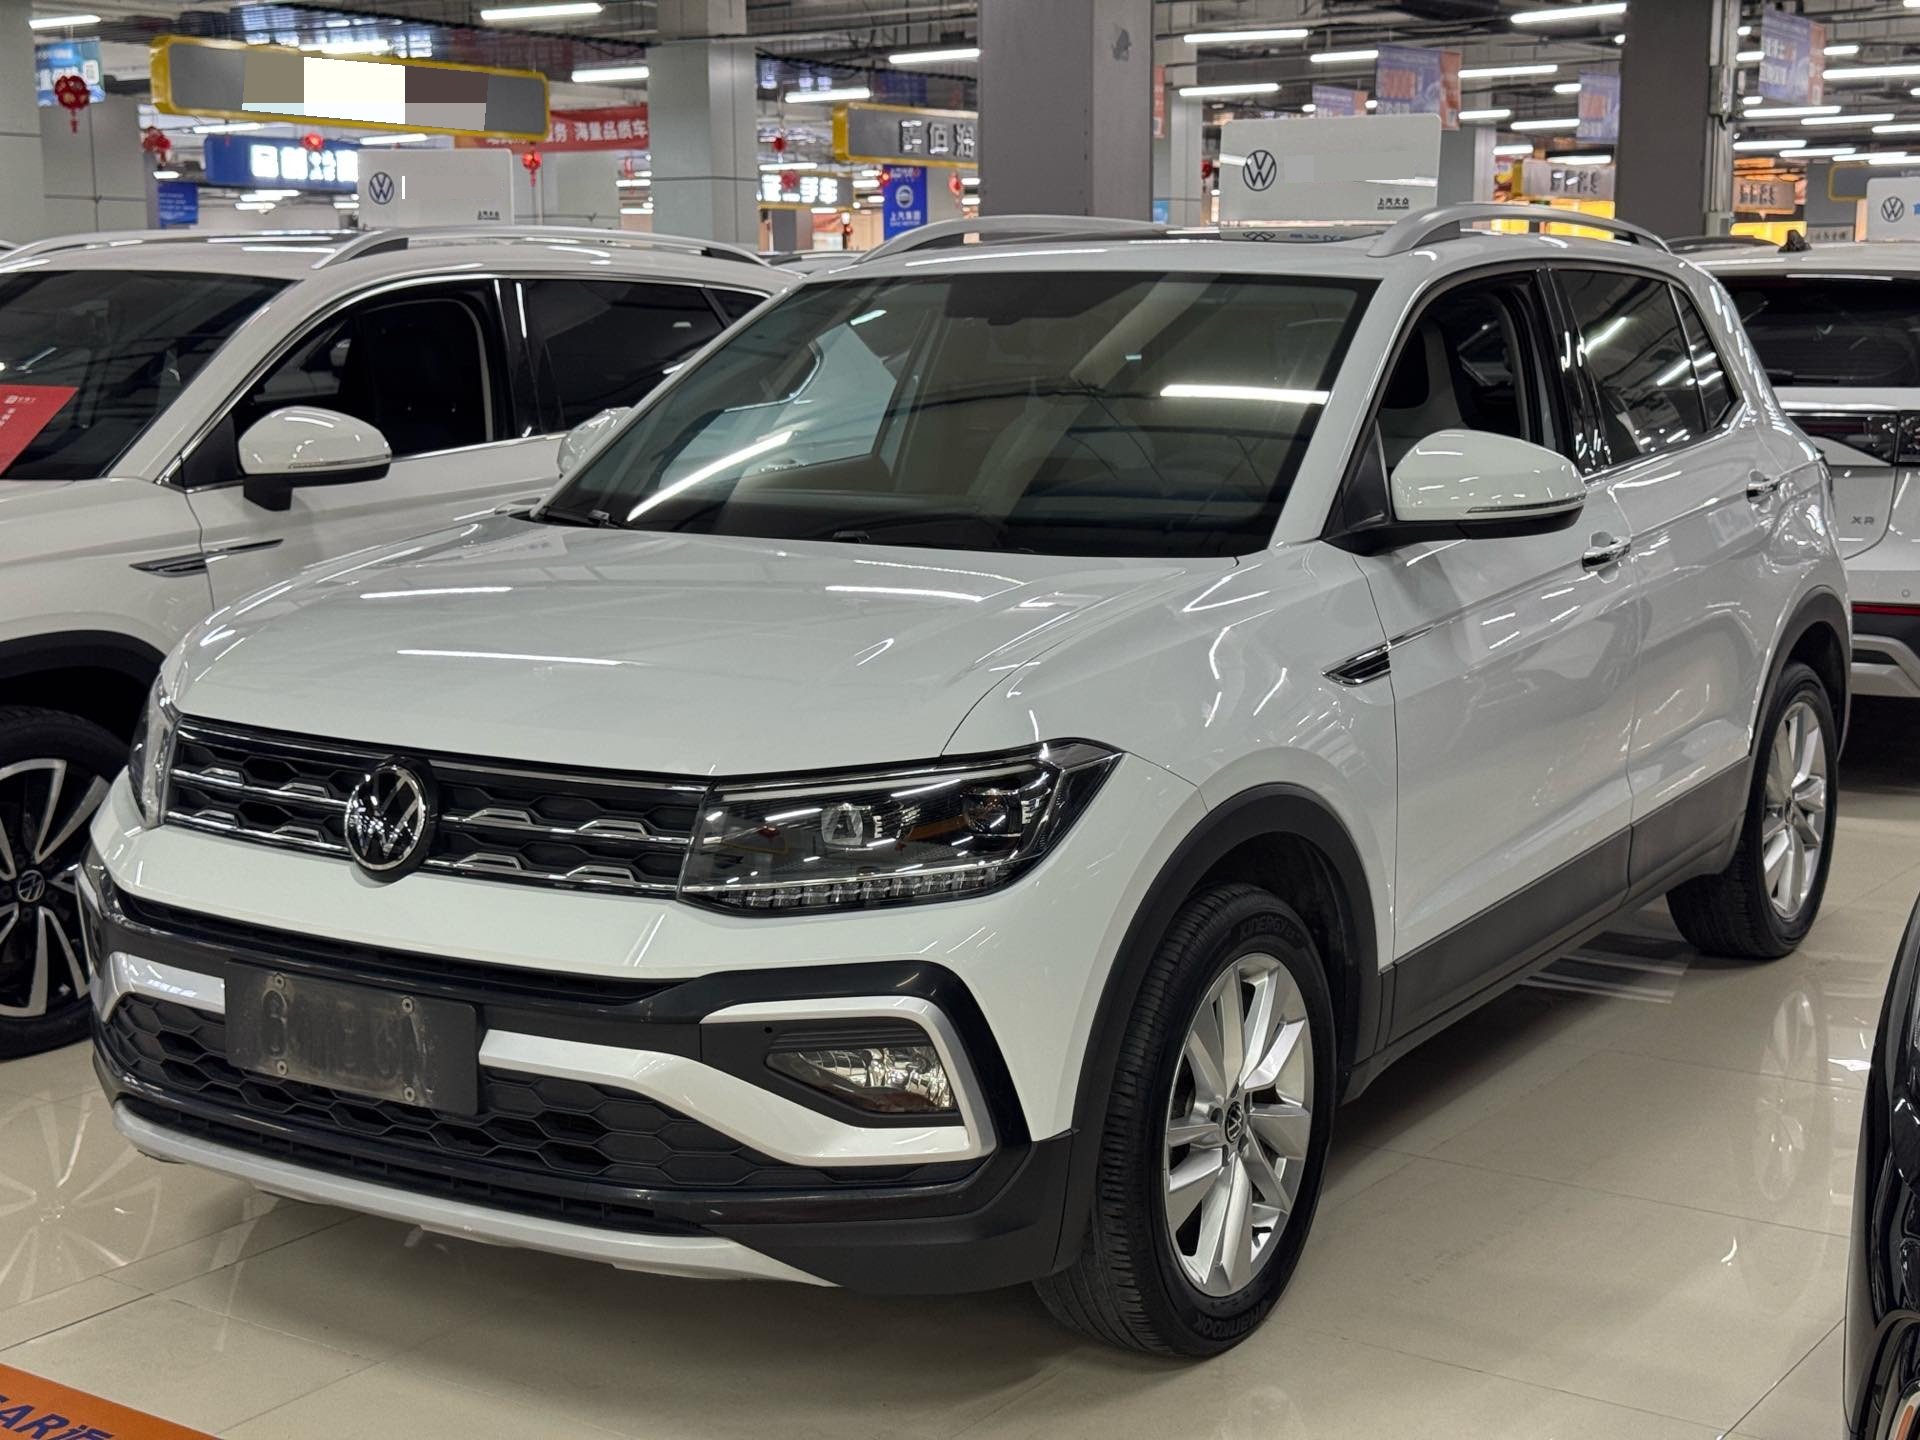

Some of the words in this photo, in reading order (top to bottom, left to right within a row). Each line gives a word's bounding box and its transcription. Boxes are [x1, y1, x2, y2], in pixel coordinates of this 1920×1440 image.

[575, 119, 648, 142] 海量品质车
[1242, 149, 1277, 192] VW
